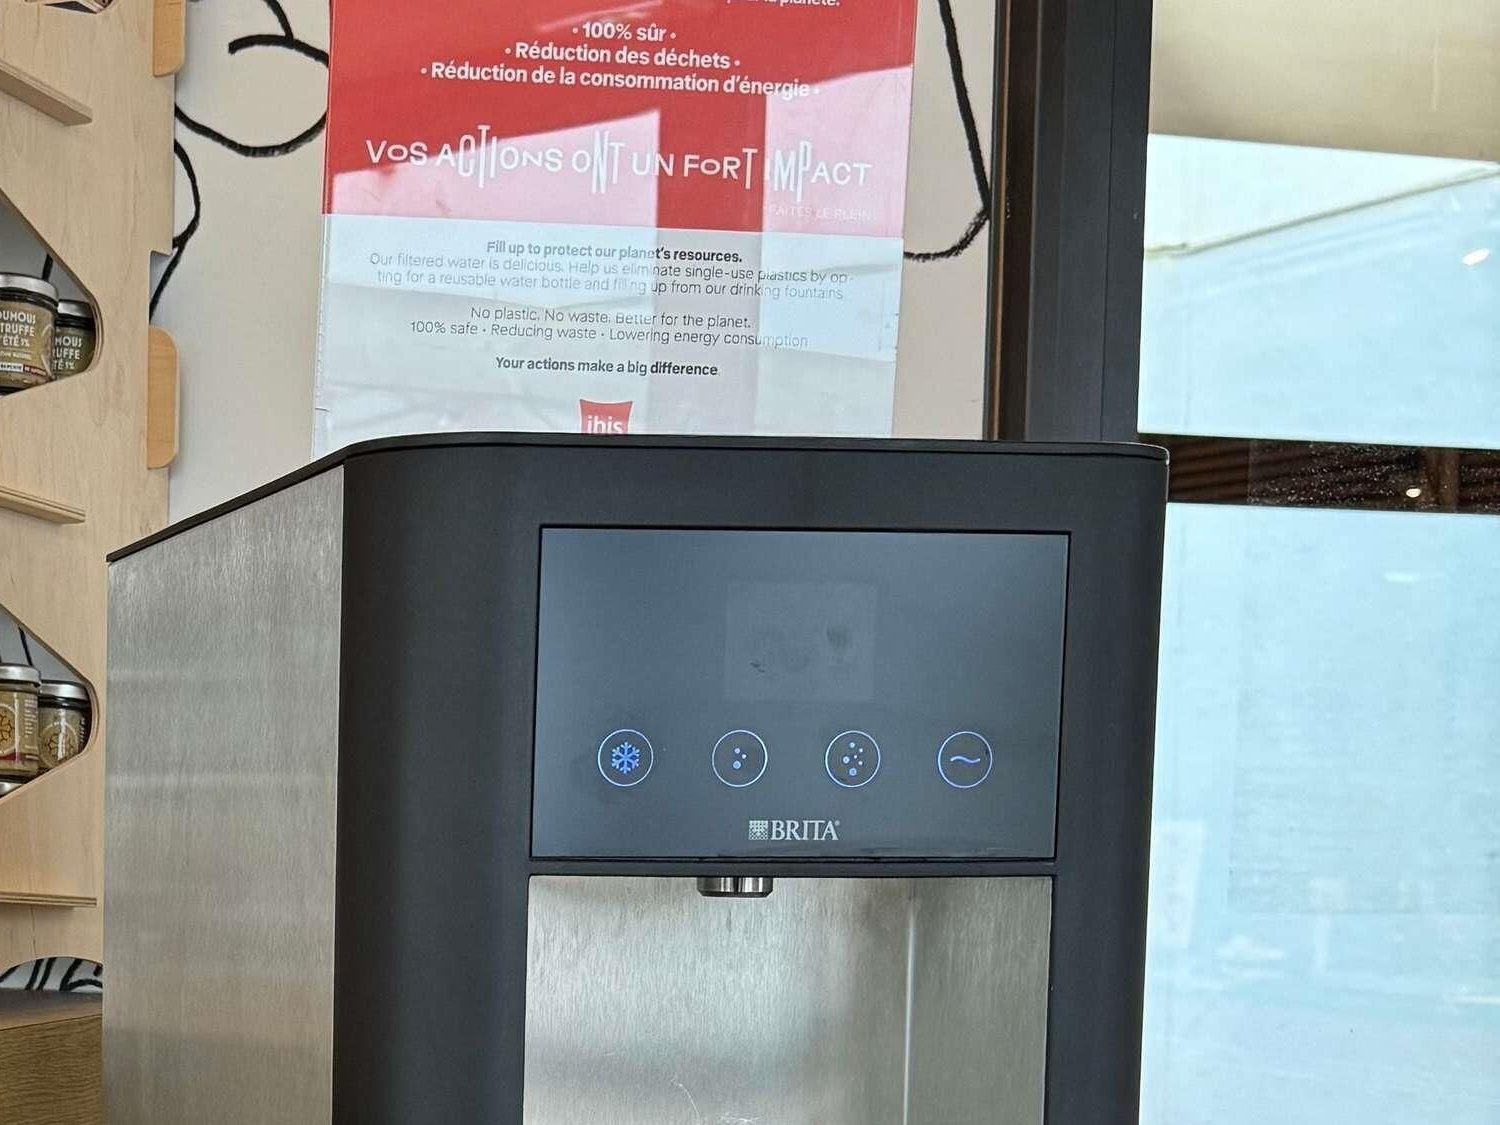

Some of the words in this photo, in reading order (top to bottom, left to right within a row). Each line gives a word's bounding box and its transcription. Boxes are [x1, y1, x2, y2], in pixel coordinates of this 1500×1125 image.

[583, 22, 632, 39] 100%
[637, 23, 667, 41] sûr
[516, 42, 610, 63] Réduction
[615, 46, 649, 65] des
[654, 49, 731, 69] déchets
[431, 62, 527, 83] Réduction
[532, 66, 556, 85] de
[560, 68, 576, 85] la
[580, 70, 720, 92] consommation
[366, 138, 429, 167] VOS
[436, 124, 564, 189] ACTIONS
[572, 128, 627, 194] ONT
[632, 150, 675, 177] UN
[683, 147, 758, 190] FORT
[487, 240, 506, 254] Fill
[510, 245, 524, 258] up
[528, 243, 541, 256] to
[544, 244, 592, 261] protect
[595, 247, 616, 259] our
[673, 250, 744, 264] resources.
[371, 253, 392, 265] Our
[396, 252, 444, 267] filtered
[448, 256, 485, 269] water
[489, 256, 499, 270] is
[569, 262, 602, 279] Help
[607, 265, 619, 276] us
[622, 263, 681, 277] eliminate
[685, 265, 753, 281] single-use
[757, 269, 807, 285] plastics
[810, 269, 827, 284] by
[378, 269, 402, 286] ting
[406, 270, 423, 284] for
[428, 274, 436, 285] a
[440, 272, 495, 289] reusable
[500, 277, 538, 291] water
[542, 276, 581, 292] bottle
[585, 279, 609, 293] and
[613, 279, 646, 297] filling
[651, 283, 667, 298] up
[670, 280, 701, 296] from
[705, 285, 727, 297] our
[730, 282, 781, 301] drinking
[0, 323, 36, 337] TRUFFE
[470, 307, 490, 320] No
[545, 308, 565, 323] No
[615, 312, 657, 326] Better
[660, 313, 679, 327] for
[683, 313, 704, 328] the
[707, 315, 752, 332] planet.
[411, 320, 446, 335] 100%
[450, 321, 478, 336] safe
[491, 323, 553, 343] Reducing
[557, 327, 597, 341] waste
[610, 329, 670, 346] Lowering
[674, 333, 720, 348] energy
[724, 333, 808, 353] consumption
[496, 357, 524, 371] Your
[528, 358, 575, 374] actions
[578, 359, 614, 374] make
[618, 363, 626, 374] a
[629, 359, 647, 377] big
[586, 415, 624, 434] ibis
